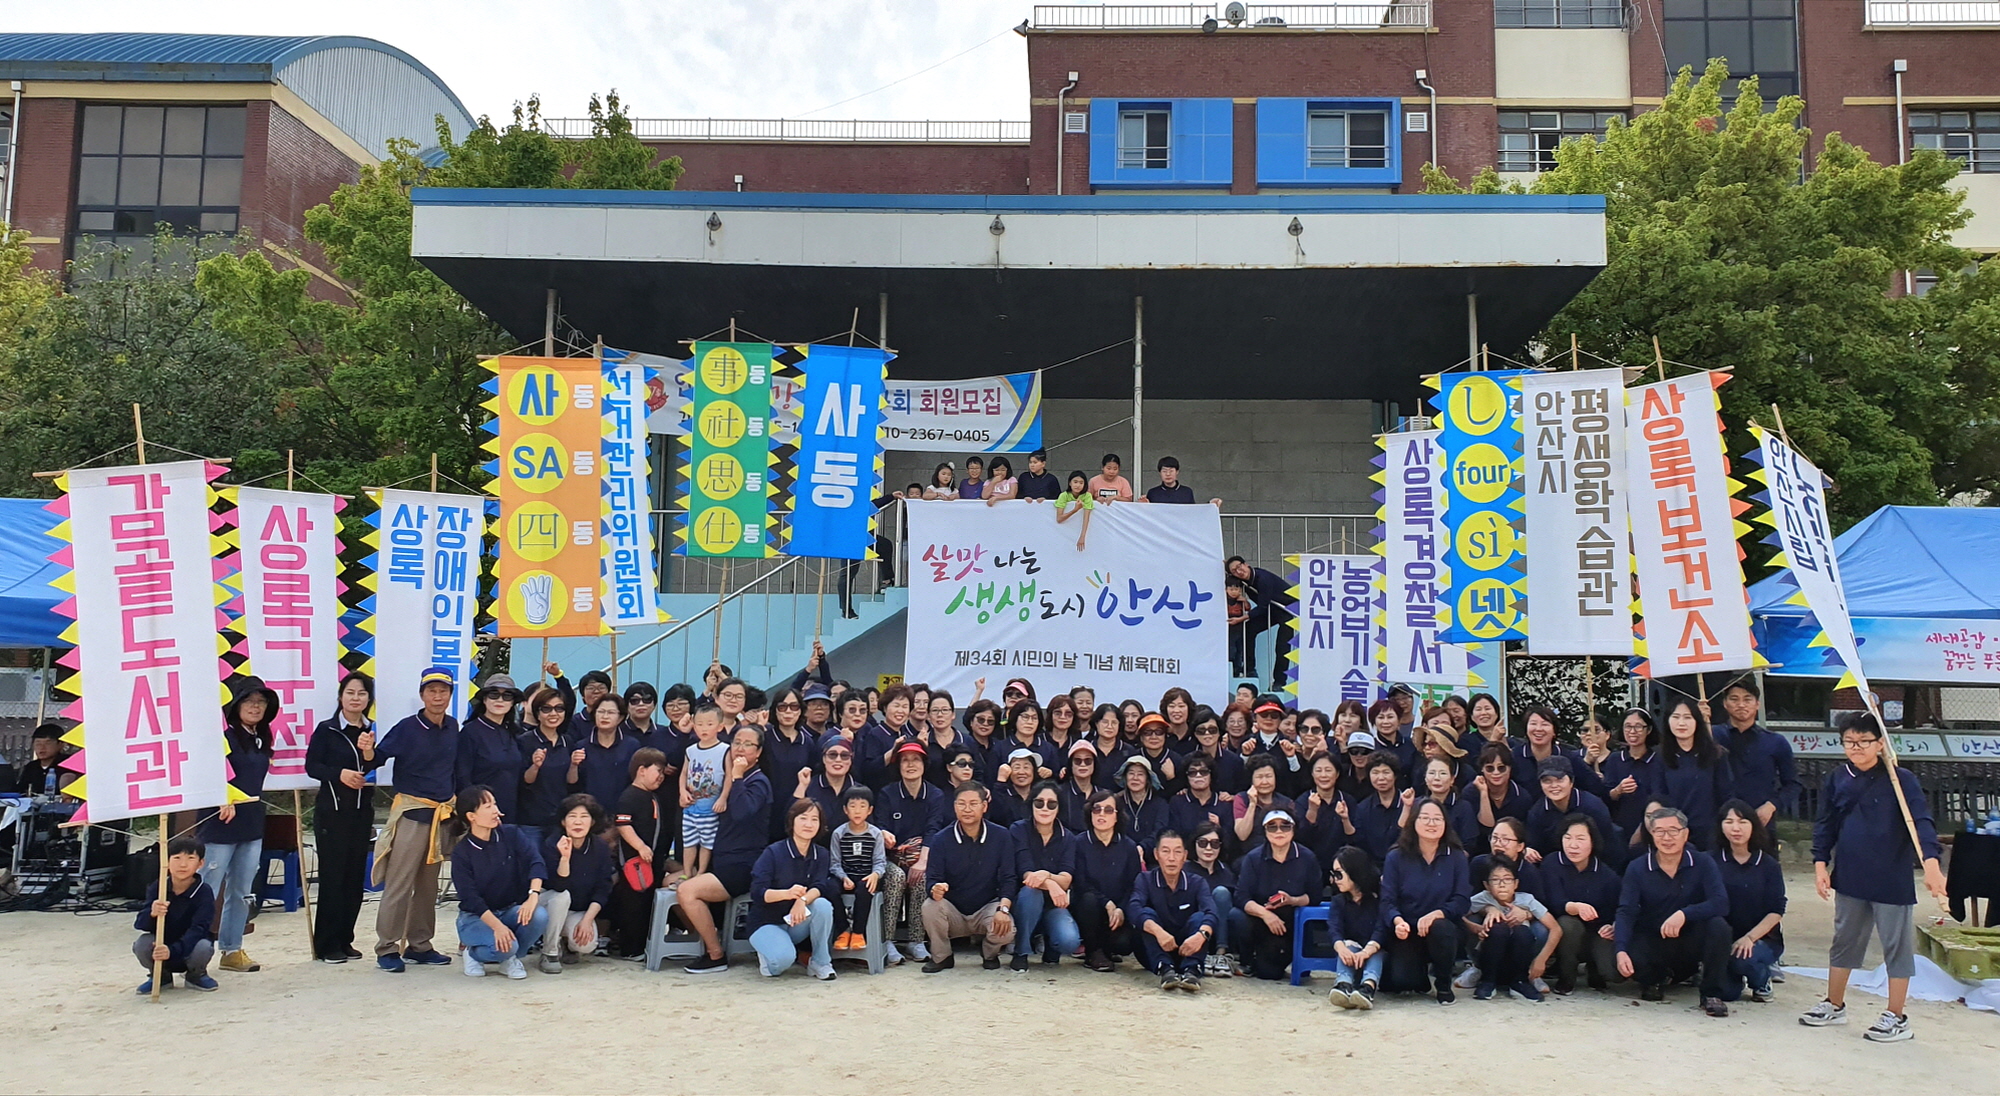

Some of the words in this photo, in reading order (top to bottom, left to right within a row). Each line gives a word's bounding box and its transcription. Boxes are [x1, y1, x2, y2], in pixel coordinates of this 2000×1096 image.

[708, 354, 742, 387] 事
[749, 365, 766, 385] 동
[573, 384, 594, 409] 동
[884, 388, 911, 415] 회
[920, 387, 1001, 415] 회원모집
[706, 408, 739, 439] 社
[748, 417, 764, 436] 동
[881, 427, 990, 442] 10-2367-0405
[810, 382, 866, 508] 사동
[1535, 391, 1567, 494] 안산시
[573, 451, 594, 475] 동
[704, 459, 737, 492] 思
[1456, 461, 1508, 485] four
[606, 370, 645, 619] 선거관리위원회
[745, 472, 762, 492] 동
[1571, 388, 1618, 617] 평생학습관
[1769, 437, 1818, 572] 안산시립
[518, 513, 560, 549] 四
[573, 521, 594, 545] 동
[702, 512, 735, 545] 仕
[743, 523, 760, 544] 동
[1640, 383, 1724, 665] 상록보건소
[388, 504, 429, 589] 상록
[1403, 438, 1443, 674] 상록경찰서
[573, 587, 594, 612] 동
[1096, 578, 1213, 630] 안산
[1309, 559, 1337, 649] 안산시
[1470, 588, 1507, 630] 넷
[107, 473, 189, 810] 감골도서관
[260, 505, 315, 775] 상록구청
[1926, 628, 1986, 649] 세대공감
[954, 648, 1007, 667] 제34회
[1012, 650, 1057, 669] 시민의
[1062, 653, 1079, 671] 날
[1083, 653, 1113, 671] 기념
[1118, 655, 1181, 675] 체육대회
[1943, 649, 1976, 671] 꿈꾸는
[1962, 739, 2000, 755] 안산
